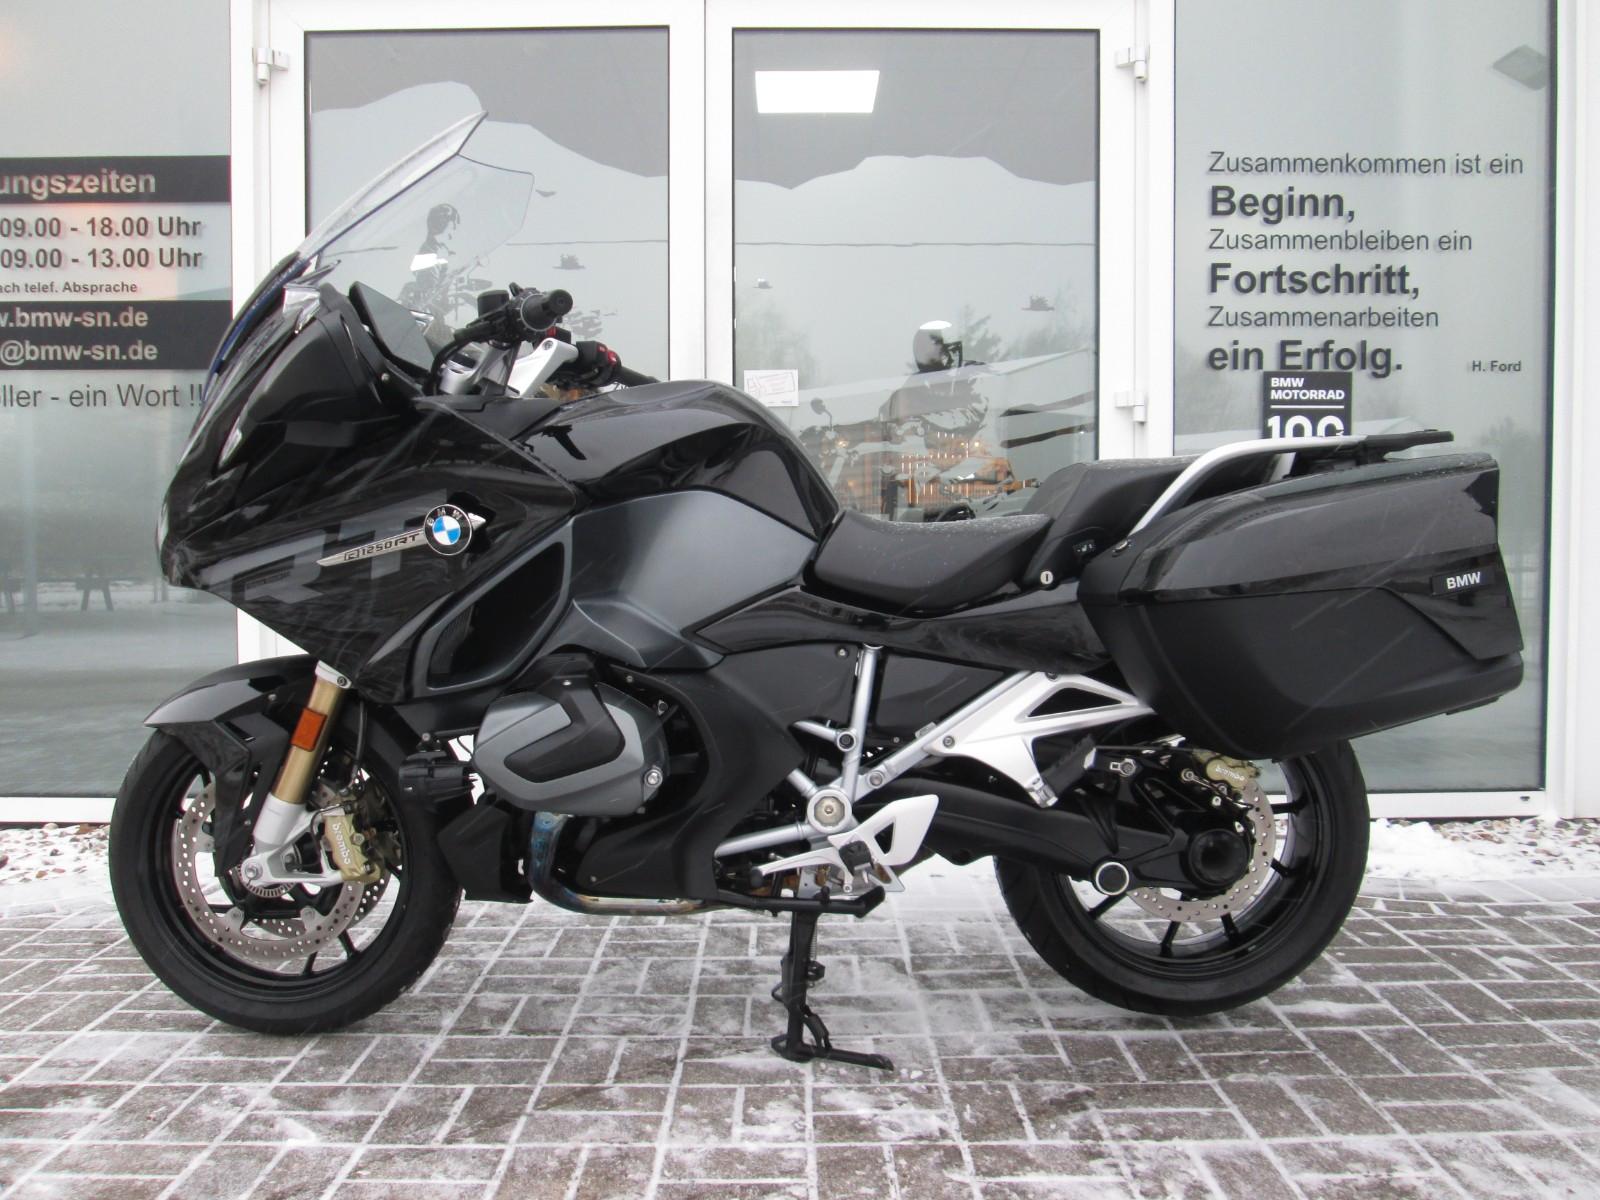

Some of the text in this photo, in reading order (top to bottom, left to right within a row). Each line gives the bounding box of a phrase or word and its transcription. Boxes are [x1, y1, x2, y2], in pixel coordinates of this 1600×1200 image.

[1208, 152, 1524, 174] Zusammenkommen ist ein
[1209, 185, 1355, 224] Beginn,
[0, 217, 61, 237] 09.00
[87, 217, 148, 236] 18.00
[158, 217, 202, 236] Uhr
[1207, 228, 1472, 250] Zusammenbleiben ein
[1, 249, 62, 268] 09.00
[87, 248, 149, 267] 13.00
[159, 248, 203, 267] Uhr
[24, 281, 58, 293] telef.
[63, 281, 137, 296] Absprache
[1209, 263, 1420, 299] Fortschritt,
[1207, 305, 1439, 327] Zusammenarbeiten
[1208, 339, 1403, 379] ein Erfolg.
[1472, 361, 1522, 372] H. Ford
[1270, 377, 1304, 387] BMW
[0, 385, 43, 407] ller
[69, 385, 106, 407] ein
[116, 384, 180, 407] Wort
[1270, 389, 1345, 400] MOTORRAD
[1446, 571, 1481, 589] BMW
[332, 823, 351, 865] brembo
